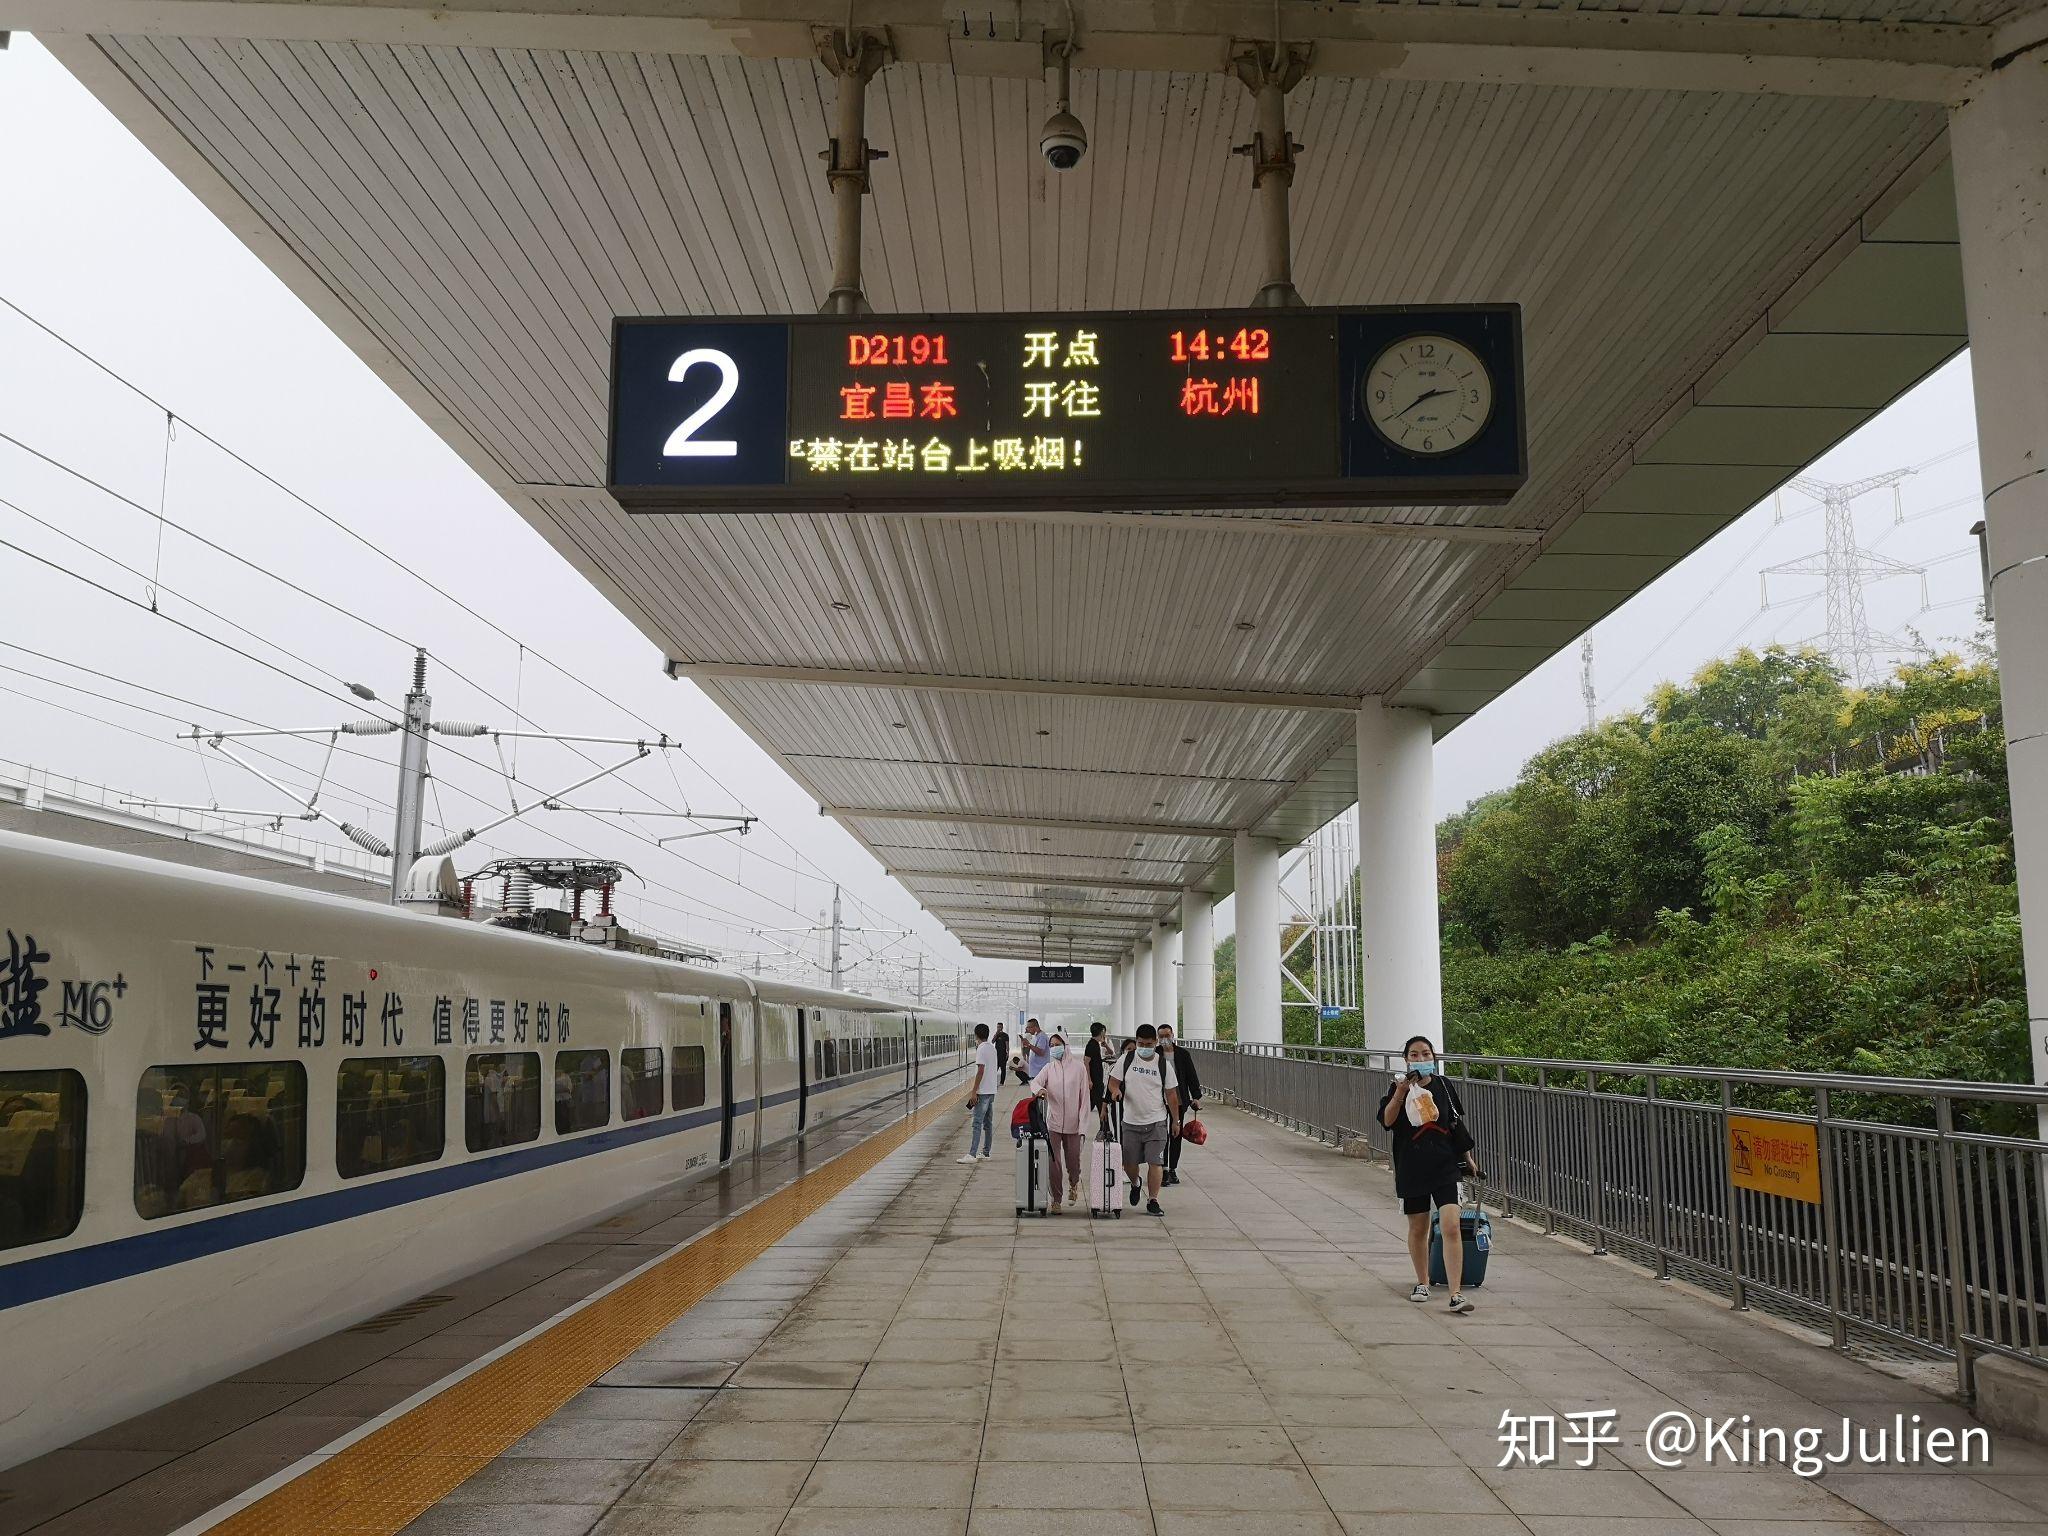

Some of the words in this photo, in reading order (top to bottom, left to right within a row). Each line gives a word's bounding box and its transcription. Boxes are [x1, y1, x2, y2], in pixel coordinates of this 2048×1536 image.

[849, 334, 948, 366] D2191
[1023, 330, 1100, 368] 开点
[1170, 329, 1270, 362] 14:42
[1418, 344, 1436, 358] 12
[662, 348, 740, 457] 2
[839, 382, 958, 420] 宜昌东
[1023, 379, 1101, 418] 开往
[1180, 376, 1260, 416] 杭州
[1375, 389, 1386, 405] 9
[1470, 389, 1480, 404] 3
[1423, 435, 1433, 450] 6
[195, 946, 327, 988] 下一个十年
[194, 983, 404, 1051] 更好的时代
[433, 995, 570, 1046] 值得更好的你
[1764, 1163, 1773, 1176] No
[1774, 1165, 1800, 1183] Crossing
